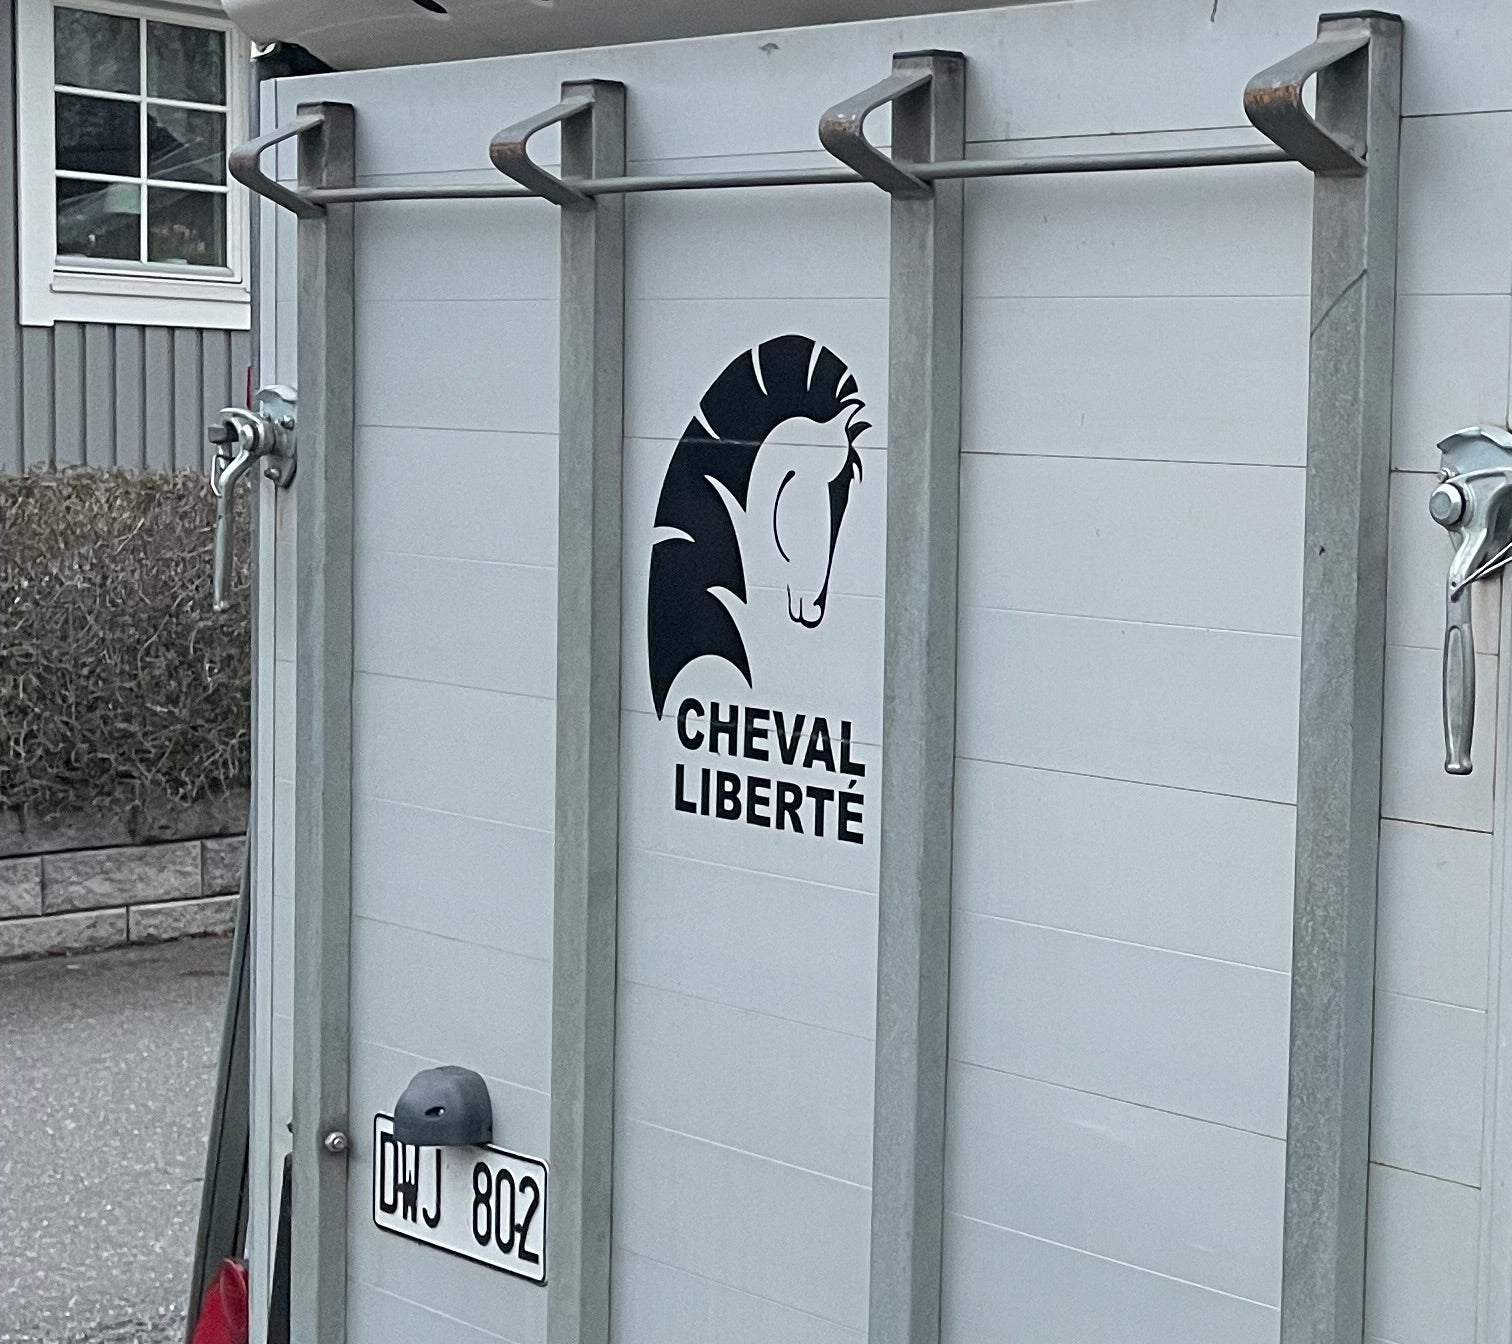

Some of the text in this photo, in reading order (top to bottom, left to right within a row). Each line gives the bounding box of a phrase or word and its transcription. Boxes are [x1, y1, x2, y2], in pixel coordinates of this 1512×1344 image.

[676, 697, 866, 777] CHEVAL
[673, 762, 865, 845] LIBERTÉ
[379, 1130, 540, 1265] DWJ 802
